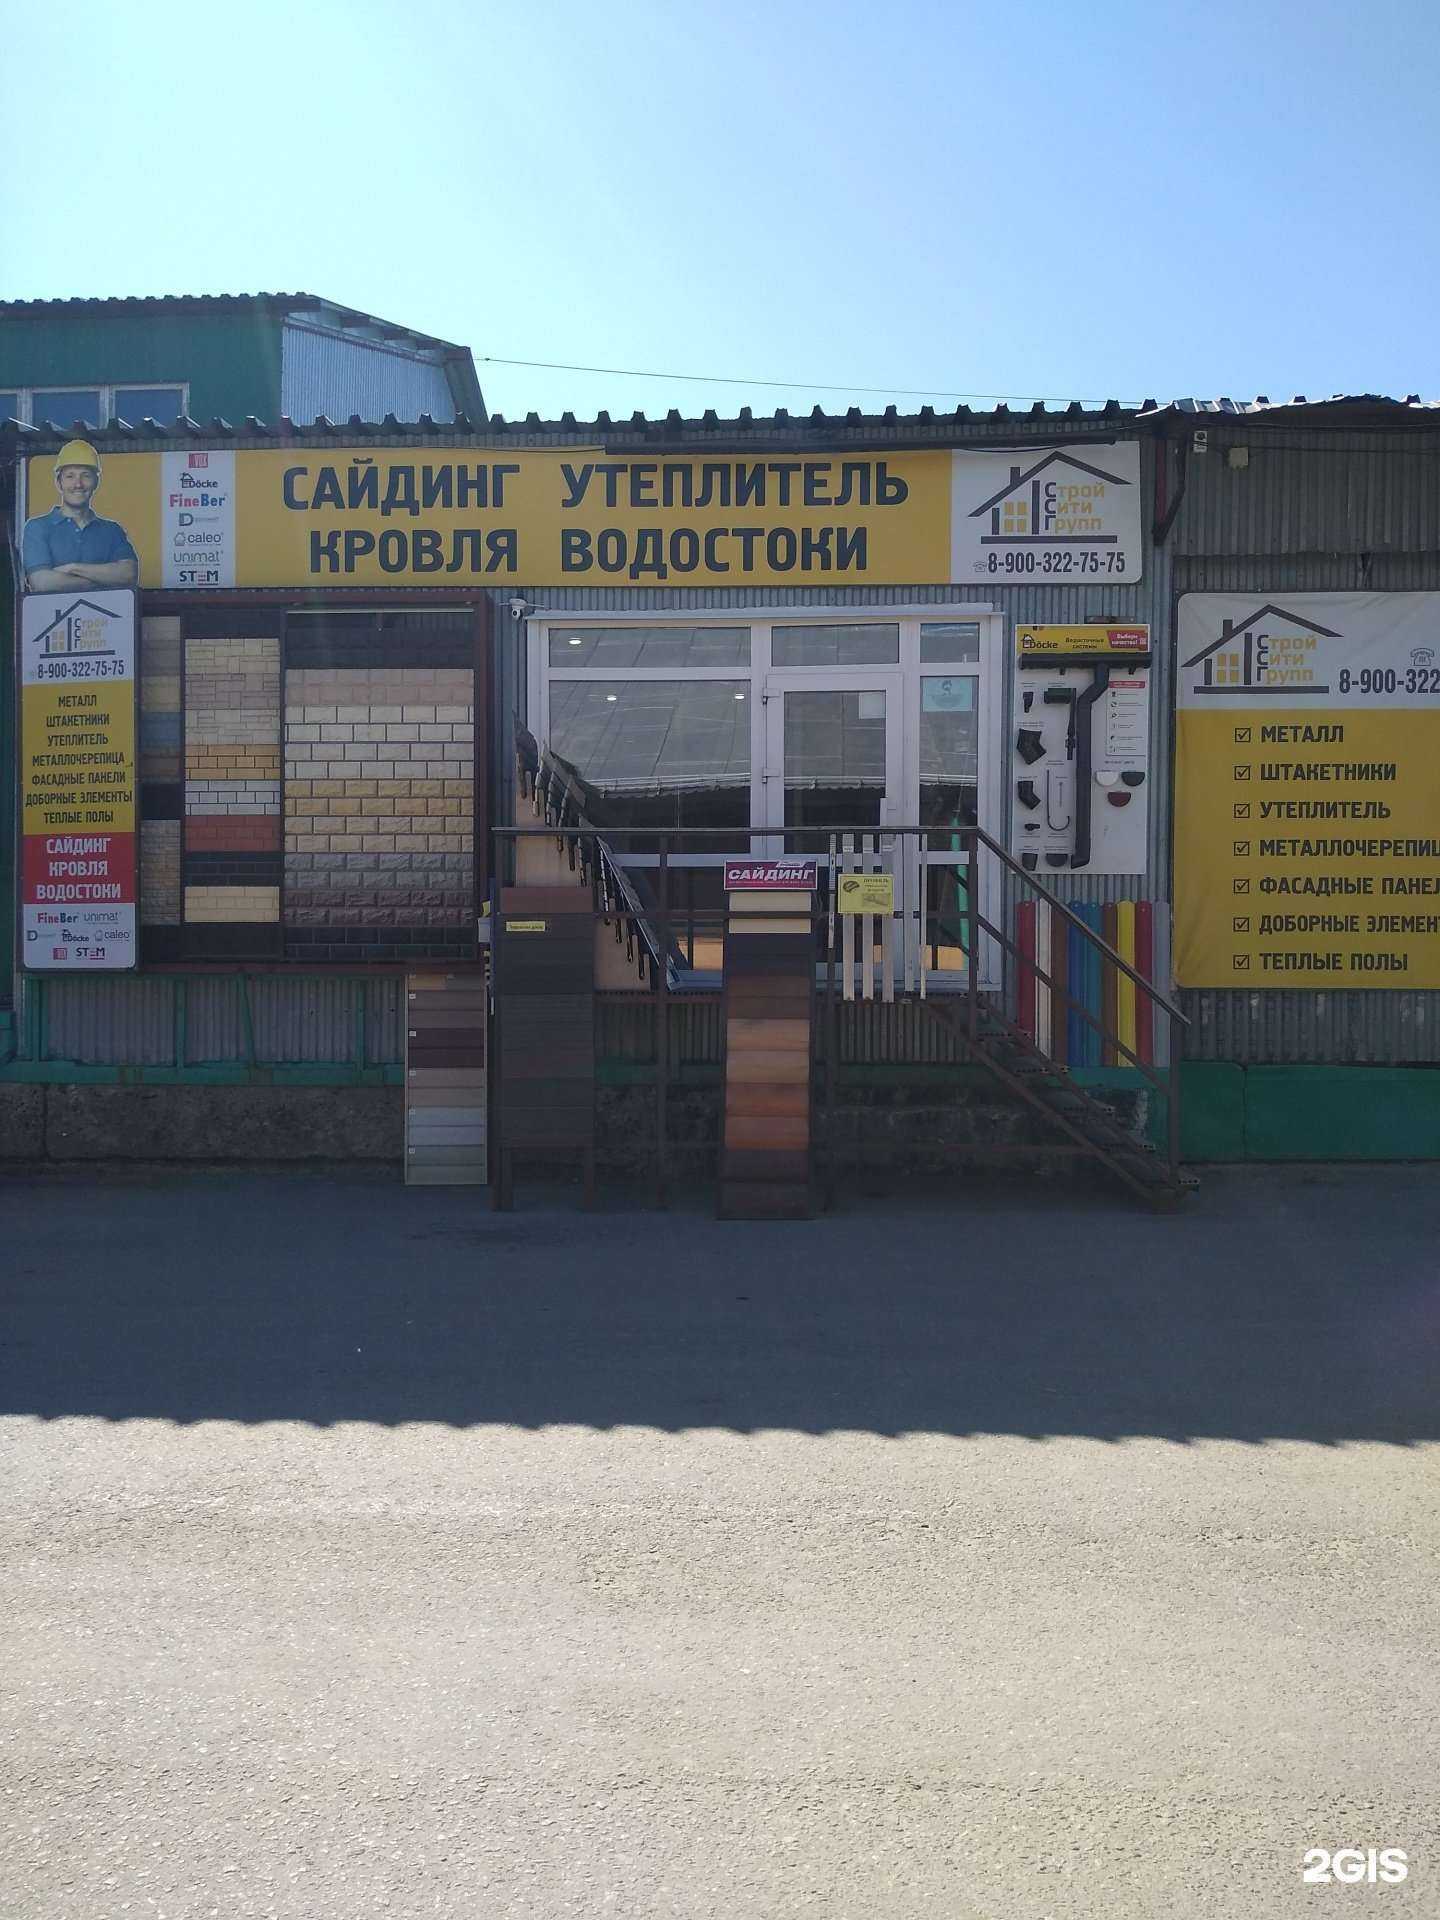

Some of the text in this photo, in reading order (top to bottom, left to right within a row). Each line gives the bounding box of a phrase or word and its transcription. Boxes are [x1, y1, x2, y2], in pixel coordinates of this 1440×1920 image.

[283, 458, 909, 517] САЙДИНГ УТЕПЛИТЕЛЬ
[1044, 481, 1105, 501] Строй
[169, 493, 225, 507] FineBer
[1044, 499, 1092, 514] Сити
[1044, 515, 1103, 533] Групп
[187, 532, 222, 543] caleo
[310, 527, 867, 580] КРОВЛЯ ВОДОСТОКИ
[988, 551, 1125, 574] 8-900-322-75-75
[1257, 635, 1317, 653] Строй
[1257, 651, 1305, 666] Сити
[38, 660, 125, 679] 8-900-322-75-75
[1257, 667, 1314, 684] Групп
[1339, 668, 1440, 694] 8-900-322
[58, 694, 97, 708] МЕТАЛЛ
[46, 713, 110, 728] ШТАКЕТНИКИ
[47, 733, 109, 747] УТЕПЛИТЕЛЬ
[1261, 725, 1344, 743] МЕТАЛЛ
[32, 752, 126, 767] МЕТАЛЛОЧЕРЕПИЦА
[31, 771, 126, 787] ФАСАДНЫЕ ПАНЕЛИ
[1260, 763, 1397, 781] ШТАКЕТНИКИ
[25, 790, 133, 808] ДОБОРНЫЕ ЭЛЕМЕНТЫ
[43, 810, 114, 824] ТЕПЛЫЕ ПОЛЫ
[1259, 801, 1391, 819] УТЕПЛИТЕЛЬ
[46, 836, 112, 856] САЙДИНГ
[49, 861, 108, 877] КРОВЛЯ
[728, 867, 814, 881] САЙДИНГ
[36, 883, 121, 901] ВОДОСТОКИ
[1259, 877, 1374, 897] ФАСАДНЫЕ
[37, 912, 79, 923] FineBer
[1259, 915, 1440, 935] ДОБОРНЫЕ ЭЛЕМЕН
[1259, 953, 1408, 971] ТЕПЛЫЕ ПОЛЫ
